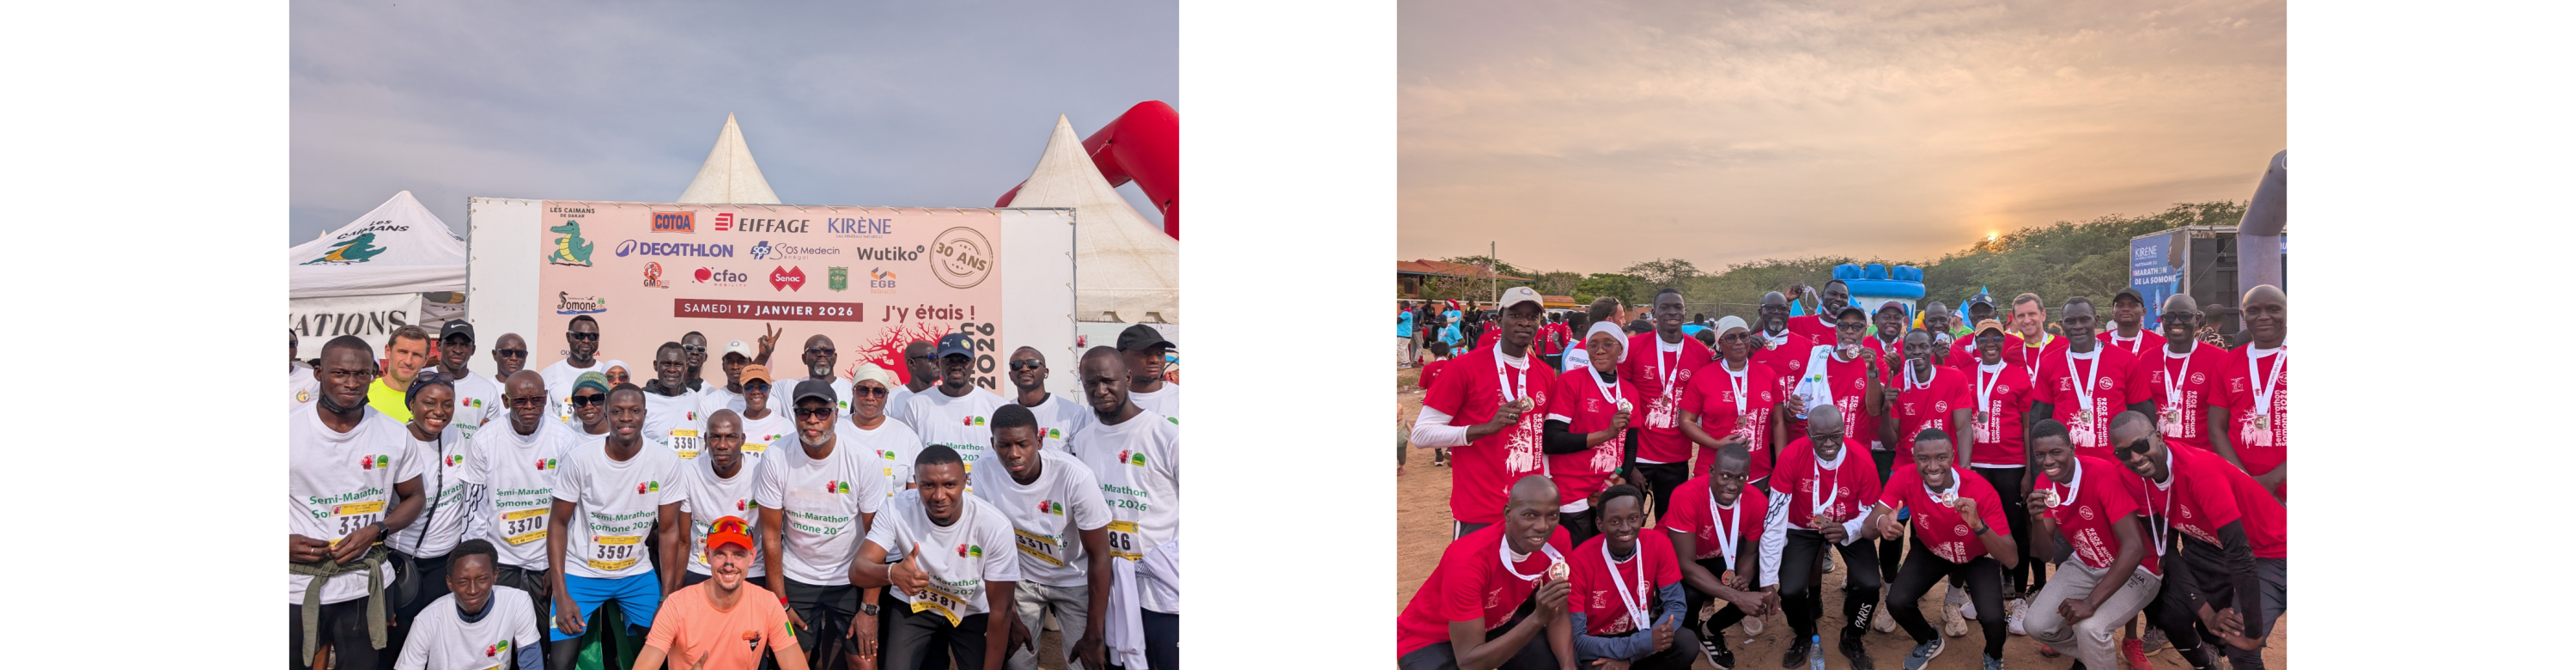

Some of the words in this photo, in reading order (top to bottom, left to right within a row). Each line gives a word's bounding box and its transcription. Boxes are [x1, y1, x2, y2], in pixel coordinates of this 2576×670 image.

[654, 215, 690, 230] COTOA
[738, 218, 811, 233] EIFFAGE
[828, 216, 891, 234] KIRÈNE
[640, 242, 733, 258] DECATHLON
[857, 247, 918, 261] Wutiko
[936, 242, 954, 258] 30
[957, 252, 987, 271] ANS
[713, 269, 747, 283] cfao
[775, 273, 800, 282] Senac
[2150, 275, 2177, 283] SOMONE
[684, 303, 732, 313] SAMEDI
[738, 305, 750, 314] 17
[755, 305, 815, 316] JANVIER
[818, 307, 854, 316] 2026
[882, 305, 909, 323] J'y
[915, 304, 963, 320] étais
[975, 322, 996, 390] 2026
[674, 437, 696, 449] 3391
[310, 487, 384, 504] Semi-Maratho
[496, 487, 553, 496] Semi-Maratho
[496, 499, 533, 508] Somone
[1118, 499, 1146, 511] 2026
[591, 510, 655, 521] Semi-Marathon
[508, 515, 542, 535] 3370
[590, 522, 630, 533] Somone
[793, 522, 821, 533] mone
[1016, 533, 1052, 555] 3371
[1109, 531, 1131, 551] 86
[598, 545, 633, 559] 3597
[2101, 546, 2114, 562] mone
[919, 589, 957, 611] 3381
[1855, 603, 1872, 629] PARIS
